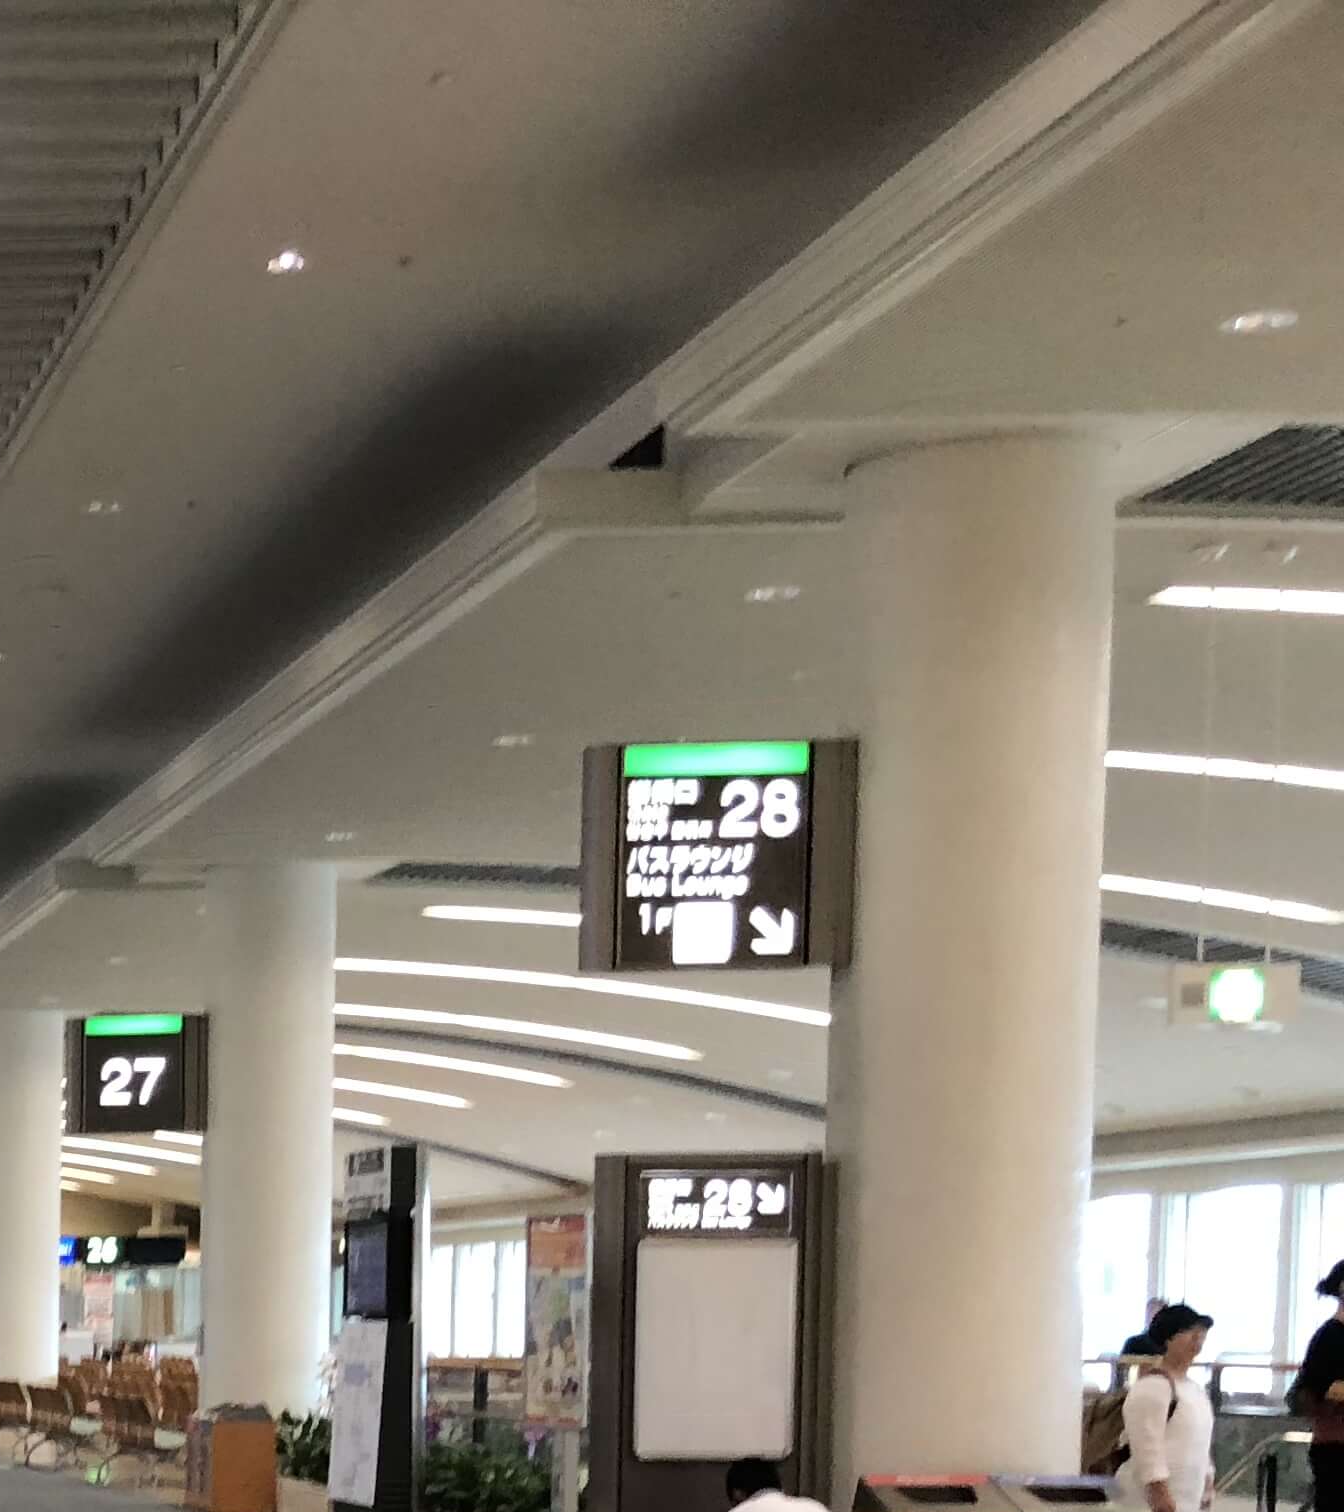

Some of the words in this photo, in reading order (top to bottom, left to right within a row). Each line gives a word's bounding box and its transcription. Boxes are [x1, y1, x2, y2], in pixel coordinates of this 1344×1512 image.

[719, 779, 800, 838] 28
[672, 872, 749, 899] Lounge
[99, 1056, 166, 1107] 27
[702, 1179, 753, 1217] 28
[87, 1236, 118, 1264] 26
